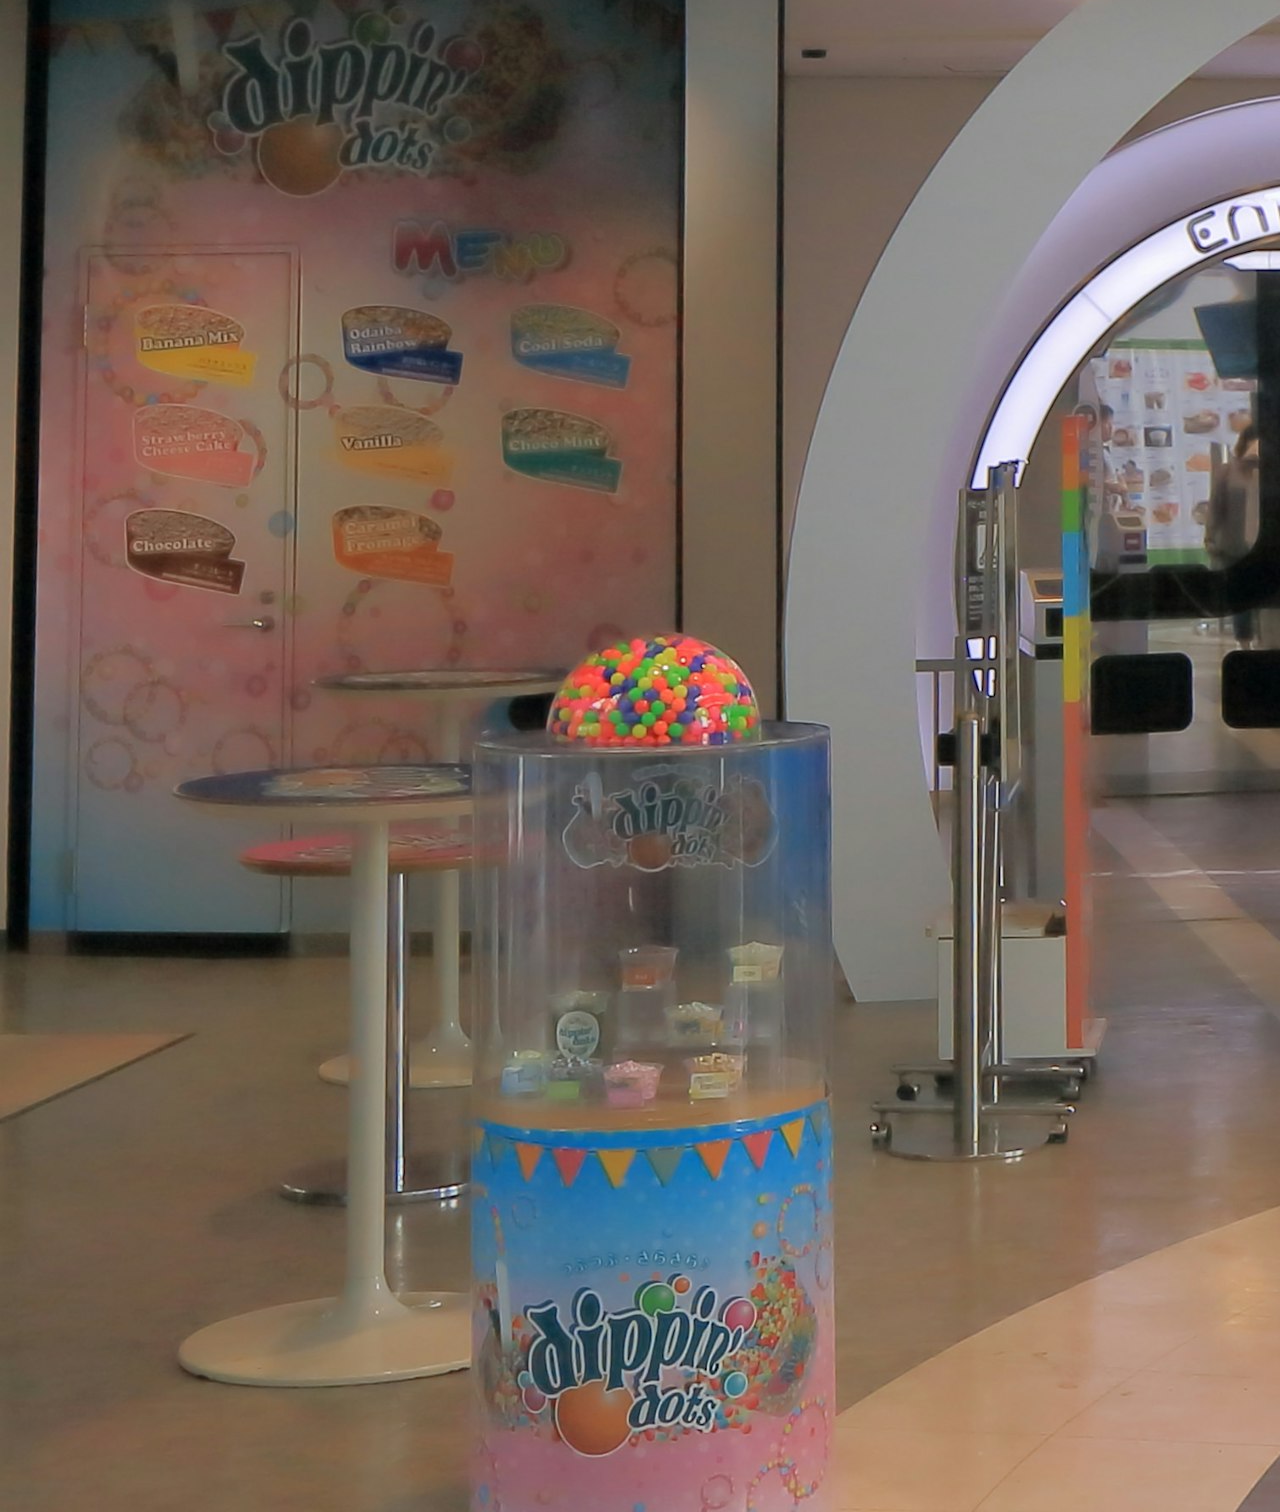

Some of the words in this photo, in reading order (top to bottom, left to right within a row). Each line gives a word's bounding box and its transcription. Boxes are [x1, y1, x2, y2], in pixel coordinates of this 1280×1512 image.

[337, 118, 437, 175] dots
[391, 220, 569, 281] MENU
[140, 336, 203, 352] Banana
[208, 331, 240, 345] Mix
[350, 339, 418, 355] Rainbow
[519, 339, 557, 354] Cool
[561, 335, 604, 350] Soda
[141, 429, 226, 445] Strawberry
[341, 434, 403, 451] Vanilla
[508, 438, 559, 452] Choco
[564, 436, 601, 449] Mint
[195, 440, 232, 453] Cake
[132, 537, 213, 553] Chocolate
[627, 1384, 720, 1432] dots
